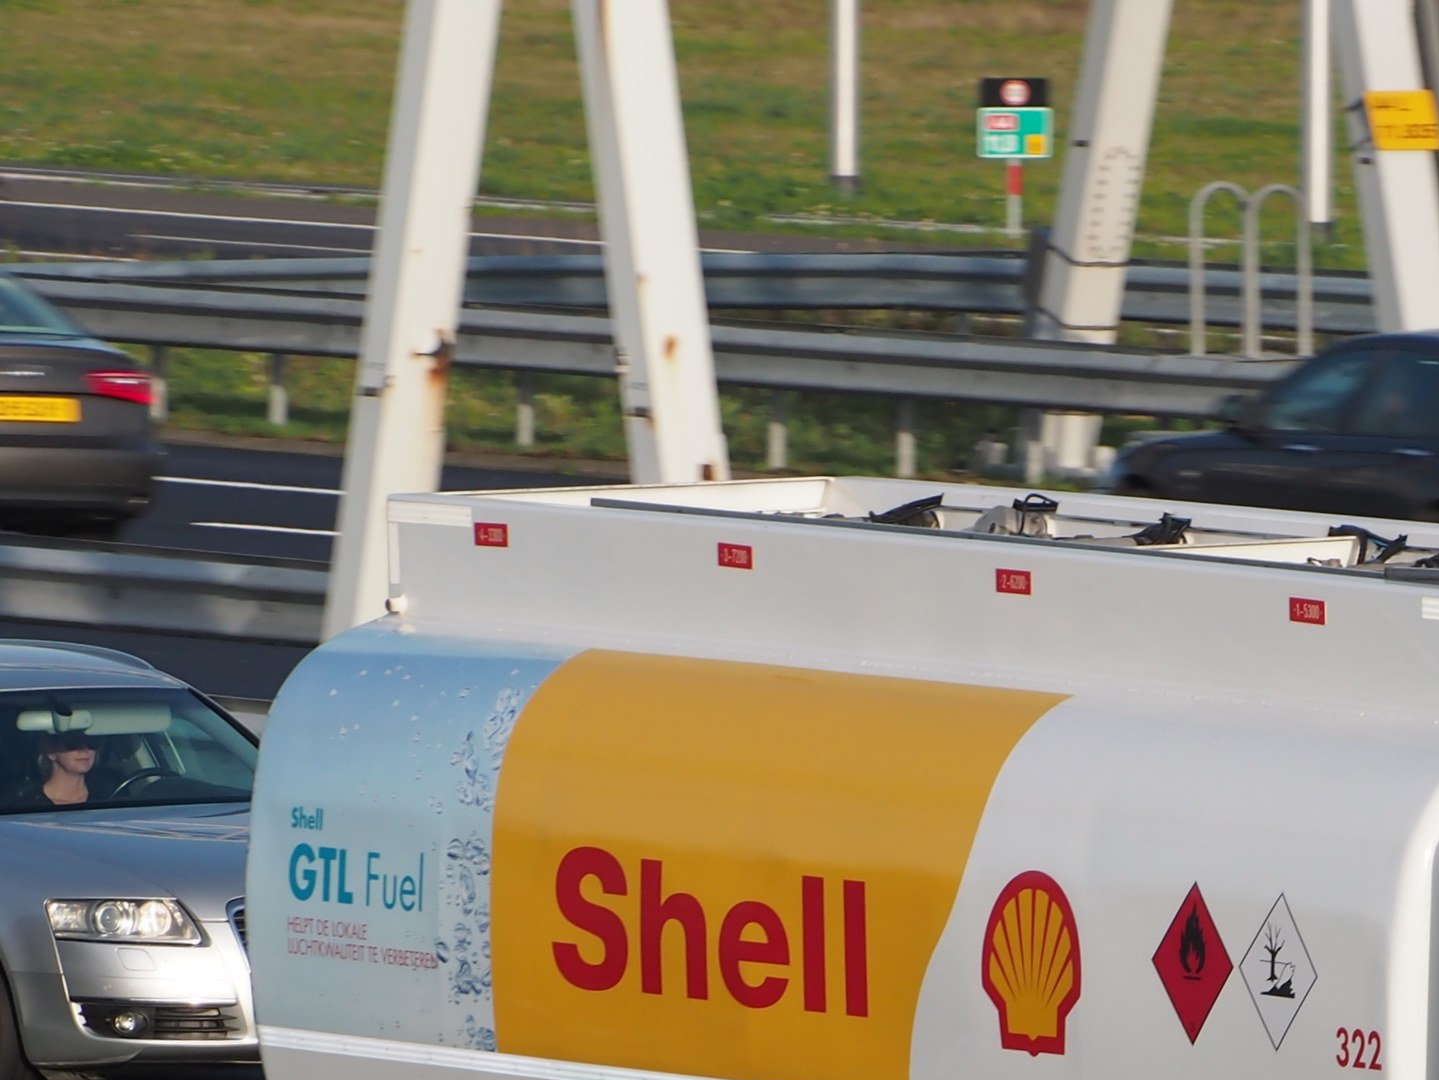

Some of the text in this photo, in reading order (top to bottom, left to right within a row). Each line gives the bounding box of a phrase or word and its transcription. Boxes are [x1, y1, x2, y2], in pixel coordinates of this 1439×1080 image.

[1295, 602, 1320, 620] 1-5300
[291, 806, 324, 831] Shell
[289, 842, 425, 913] GTL Fuel
[287, 915, 368, 941] HELPT DE LOKALE
[551, 846, 869, 1018] Shell
[367, 944, 379, 964] TE
[1336, 1027, 1382, 1071] 322
